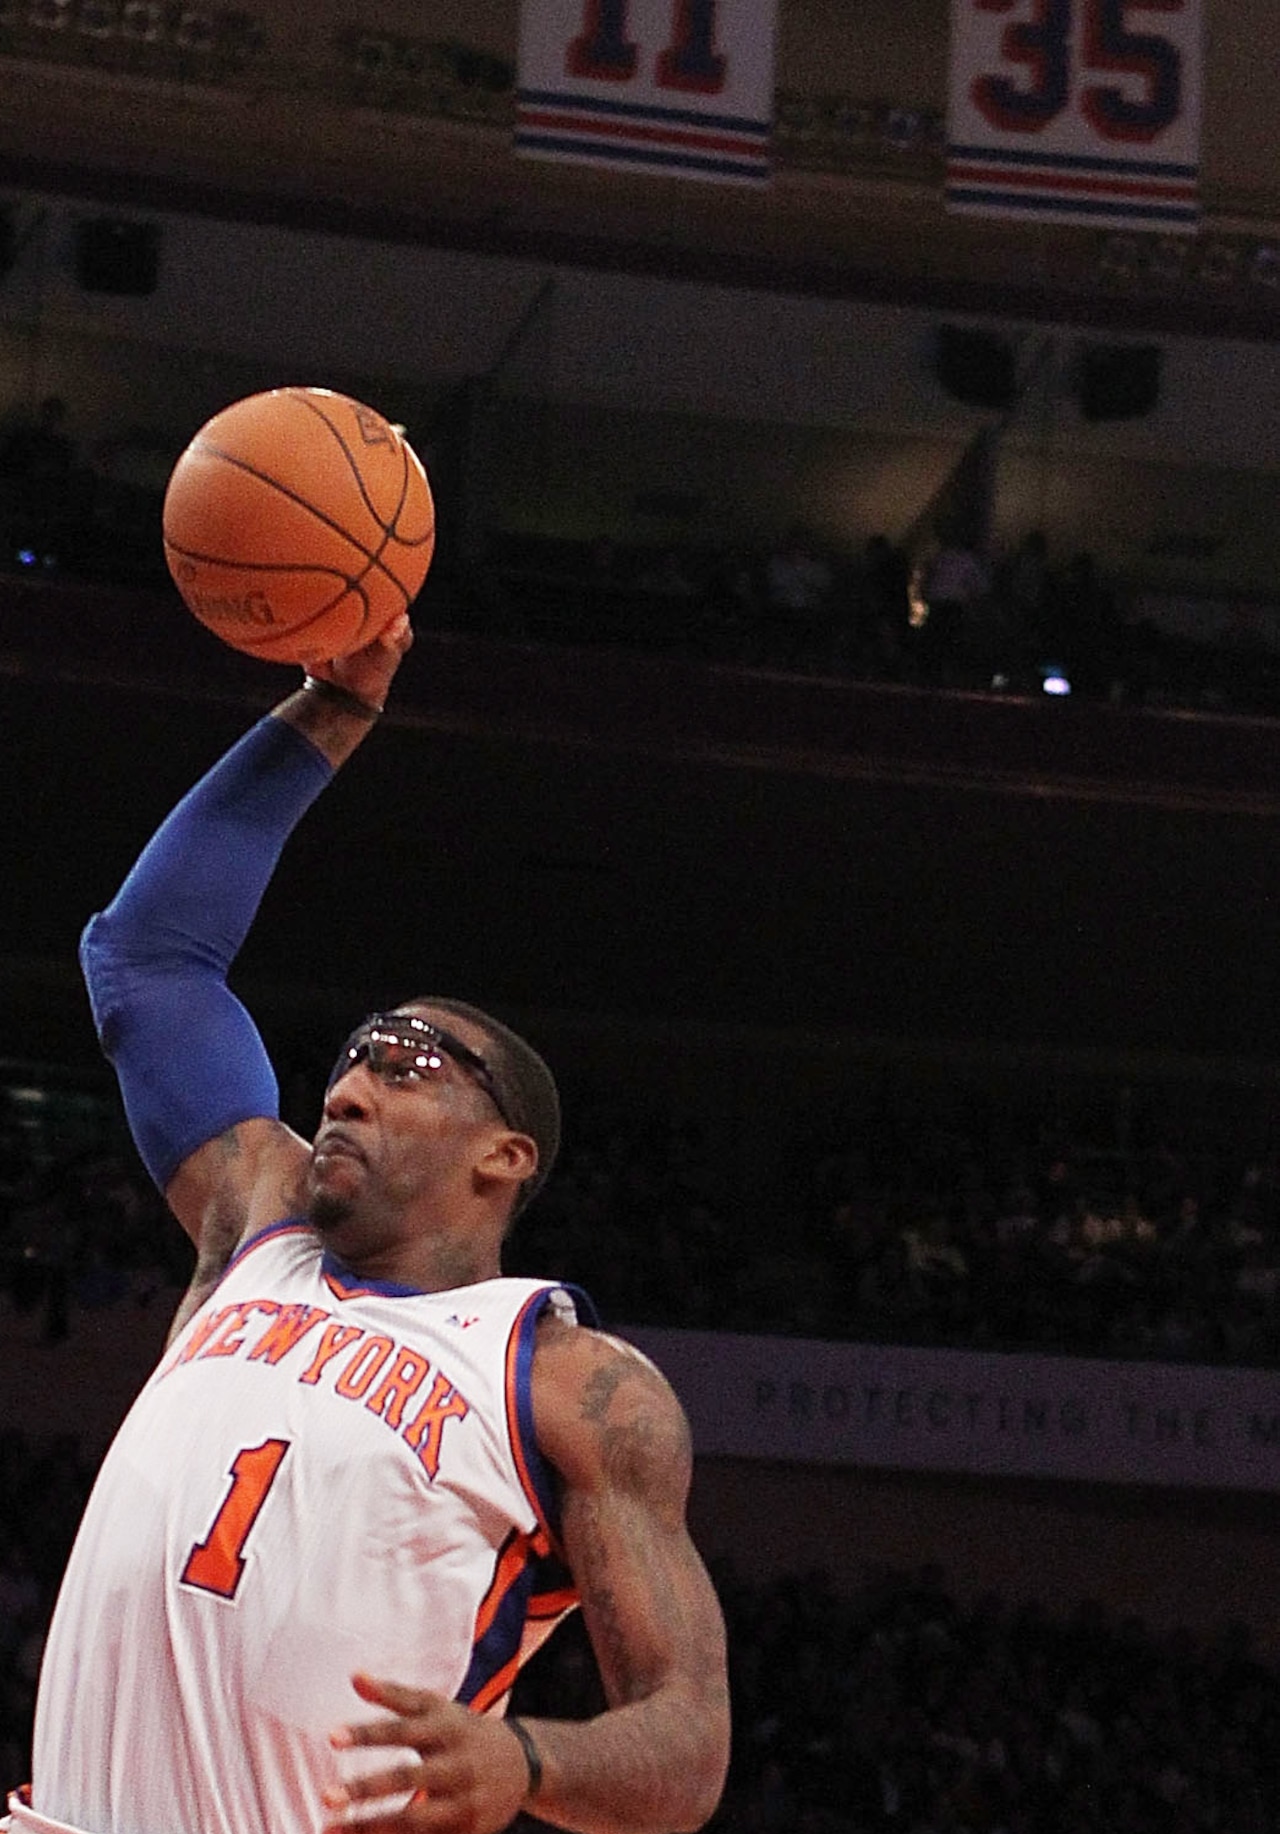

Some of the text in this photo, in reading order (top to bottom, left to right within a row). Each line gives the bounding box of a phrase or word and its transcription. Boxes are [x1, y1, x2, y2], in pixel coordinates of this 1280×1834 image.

[972, 0, 1183, 143] 35
[157, 1299, 470, 1483] NEW YORK
[179, 1437, 292, 1601] 1
